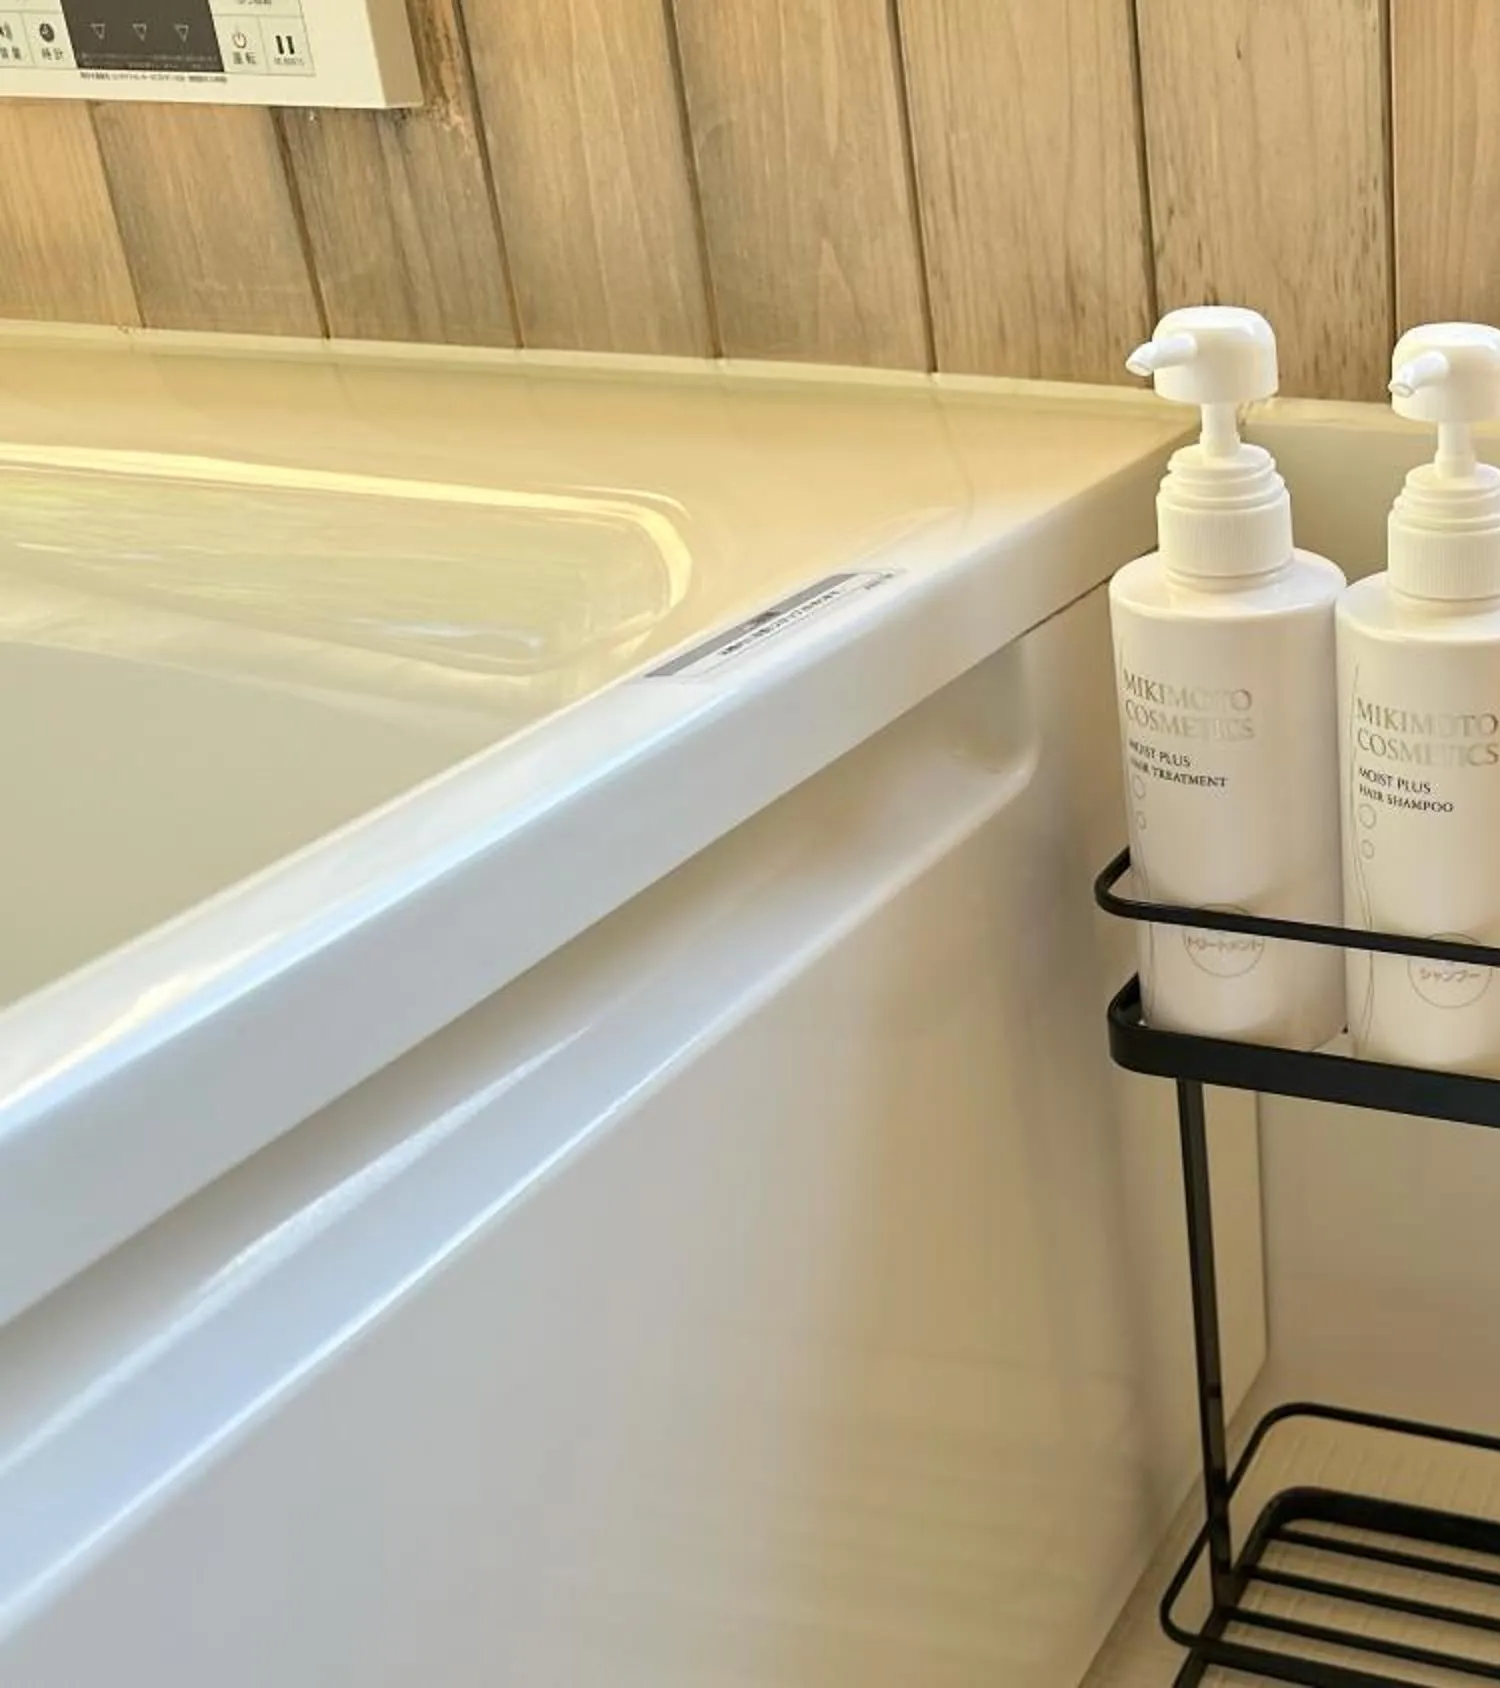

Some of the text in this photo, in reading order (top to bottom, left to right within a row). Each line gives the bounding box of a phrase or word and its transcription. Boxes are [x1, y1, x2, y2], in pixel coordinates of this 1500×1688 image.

[1123, 667, 1253, 712] MIKIMOTO
[1125, 699, 1256, 743] COSMETICS
[1356, 696, 1499, 738] MIKIMOTO
[1129, 739, 1191, 768] MOIST PLUS
[1357, 727, 1499, 768] COSMETICS
[1152, 765, 1229, 788] TREATMENT
[1358, 766, 1431, 794] MOIST PLUS
[1358, 783, 1454, 814] HAIR SHAMPOO
[1419, 966, 1481, 982] シャンプー
